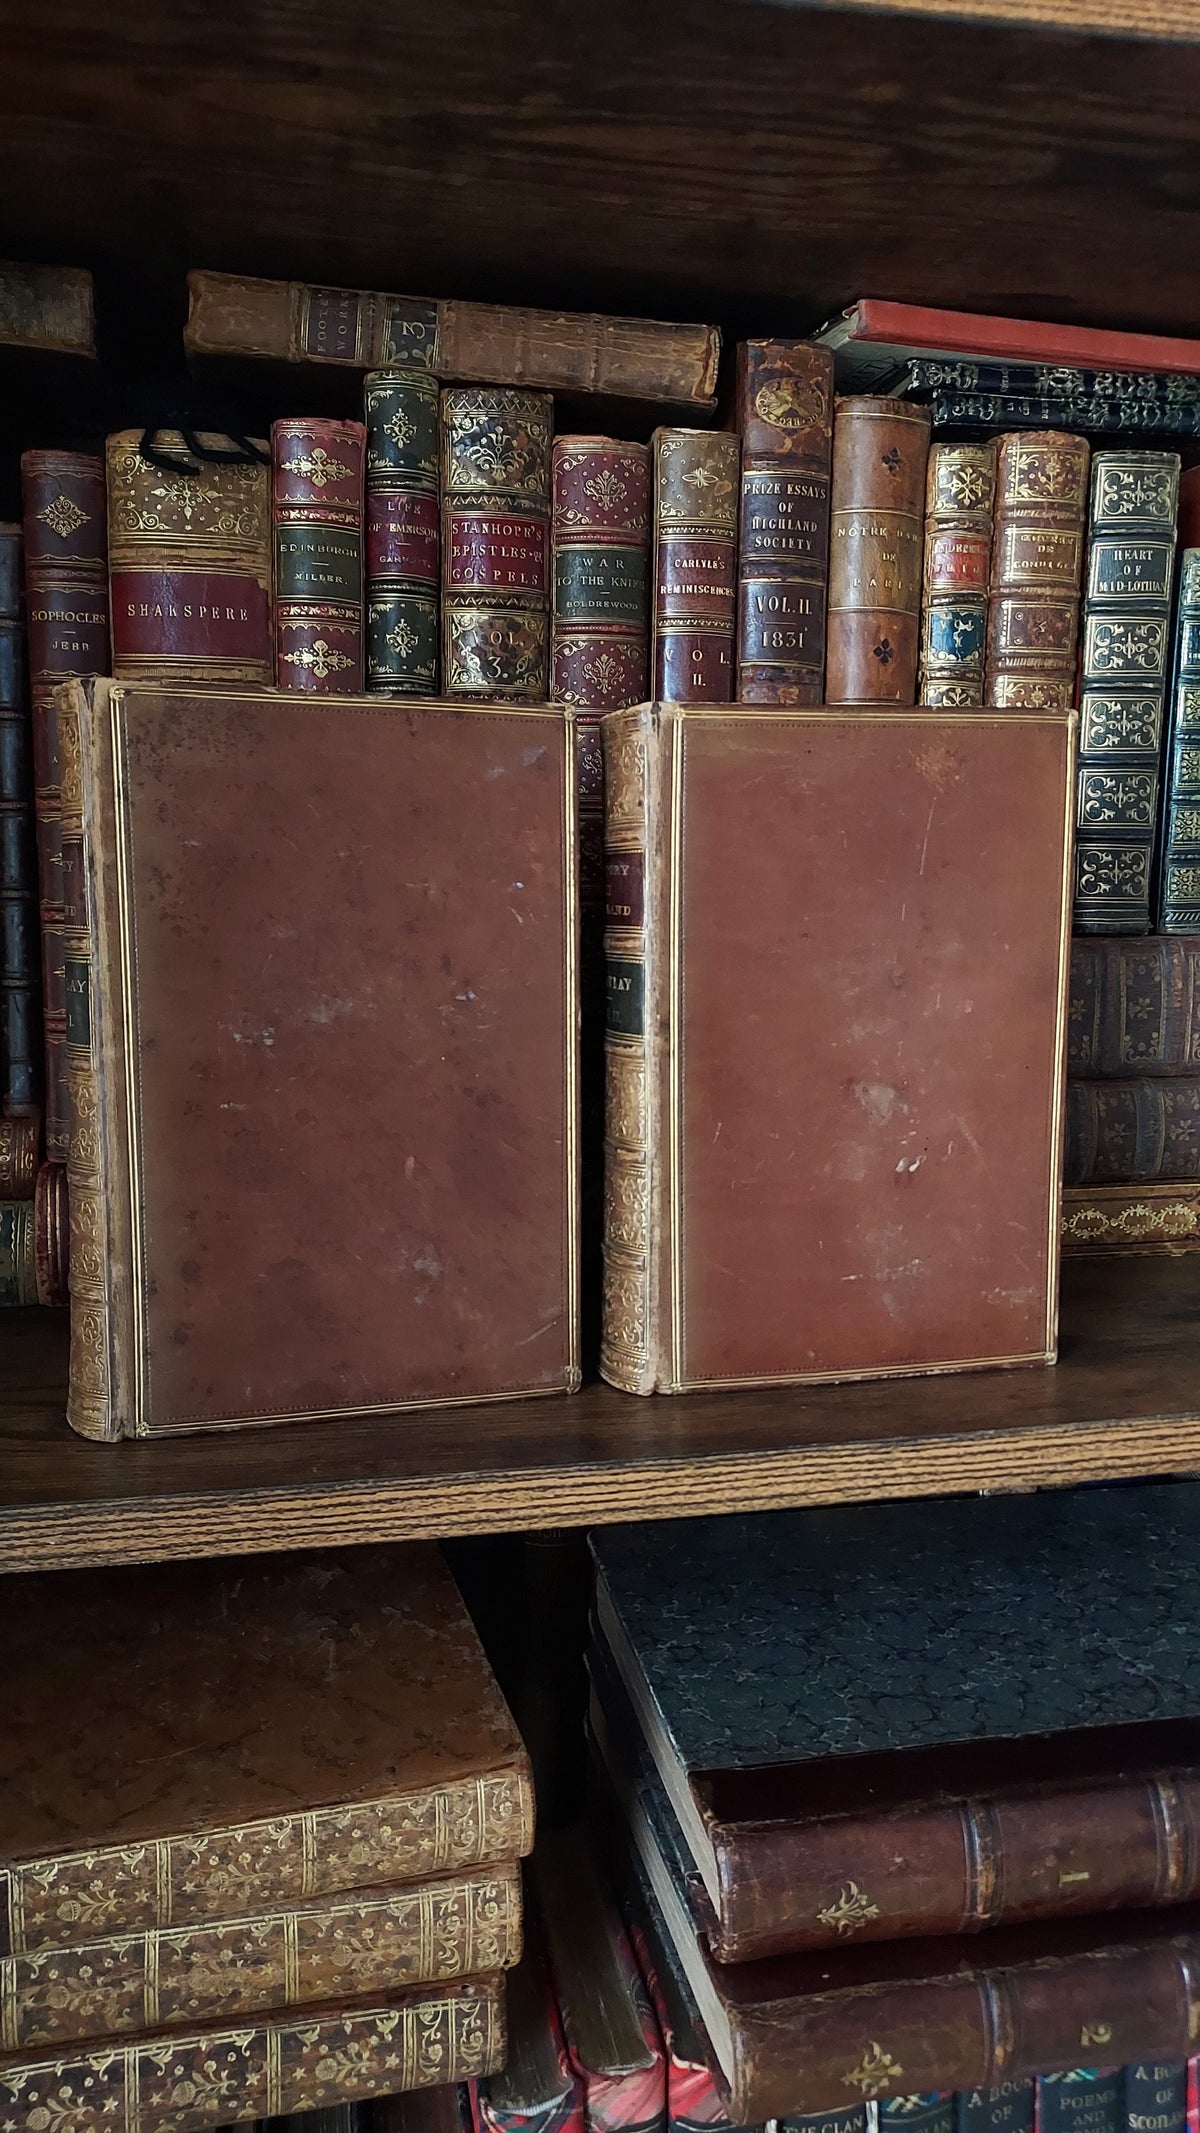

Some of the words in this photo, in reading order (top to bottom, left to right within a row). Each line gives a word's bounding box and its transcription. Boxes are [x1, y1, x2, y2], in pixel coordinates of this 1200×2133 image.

[402, 321, 426, 339] 3
[744, 483, 781, 495] PRIZE
[787, 484, 826, 499] ESSAYS
[388, 501, 421, 515] LIFE
[778, 502, 795, 513] OF
[368, 522, 383, 533] OF
[389, 523, 438, 539] EMERSON
[452, 522, 542, 541] STANHOPE'S
[752, 517, 818, 533] HIGHLAND
[838, 527, 887, 538] NOTRE
[755, 536, 812, 550] SOCIETY
[280, 544, 358, 558] EDINBURGH
[452, 545, 527, 559] EPISTLES
[1114, 549, 1154, 561] HEART
[582, 557, 625, 570] WAR
[674, 556, 725, 570] CARLYLE'S
[1123, 564, 1142, 576] OF
[452, 567, 539, 585] GOSPELS
[557, 576, 572, 586] TO
[580, 576, 604, 586] THE
[128, 603, 249, 621] SHAKSPERE
[757, 596, 796, 614] VOL.
[31, 610, 106, 625] SOPHOCLES
[52, 640, 90, 651] JEBB
[762, 630, 804, 649] 1831
[664, 649, 730, 664] VOL.
[693, 673, 706, 686] II.
[1135, 2066, 1149, 2081] A
[967, 2091, 983, 2109] A
[991, 2105, 1013, 2124] OF
